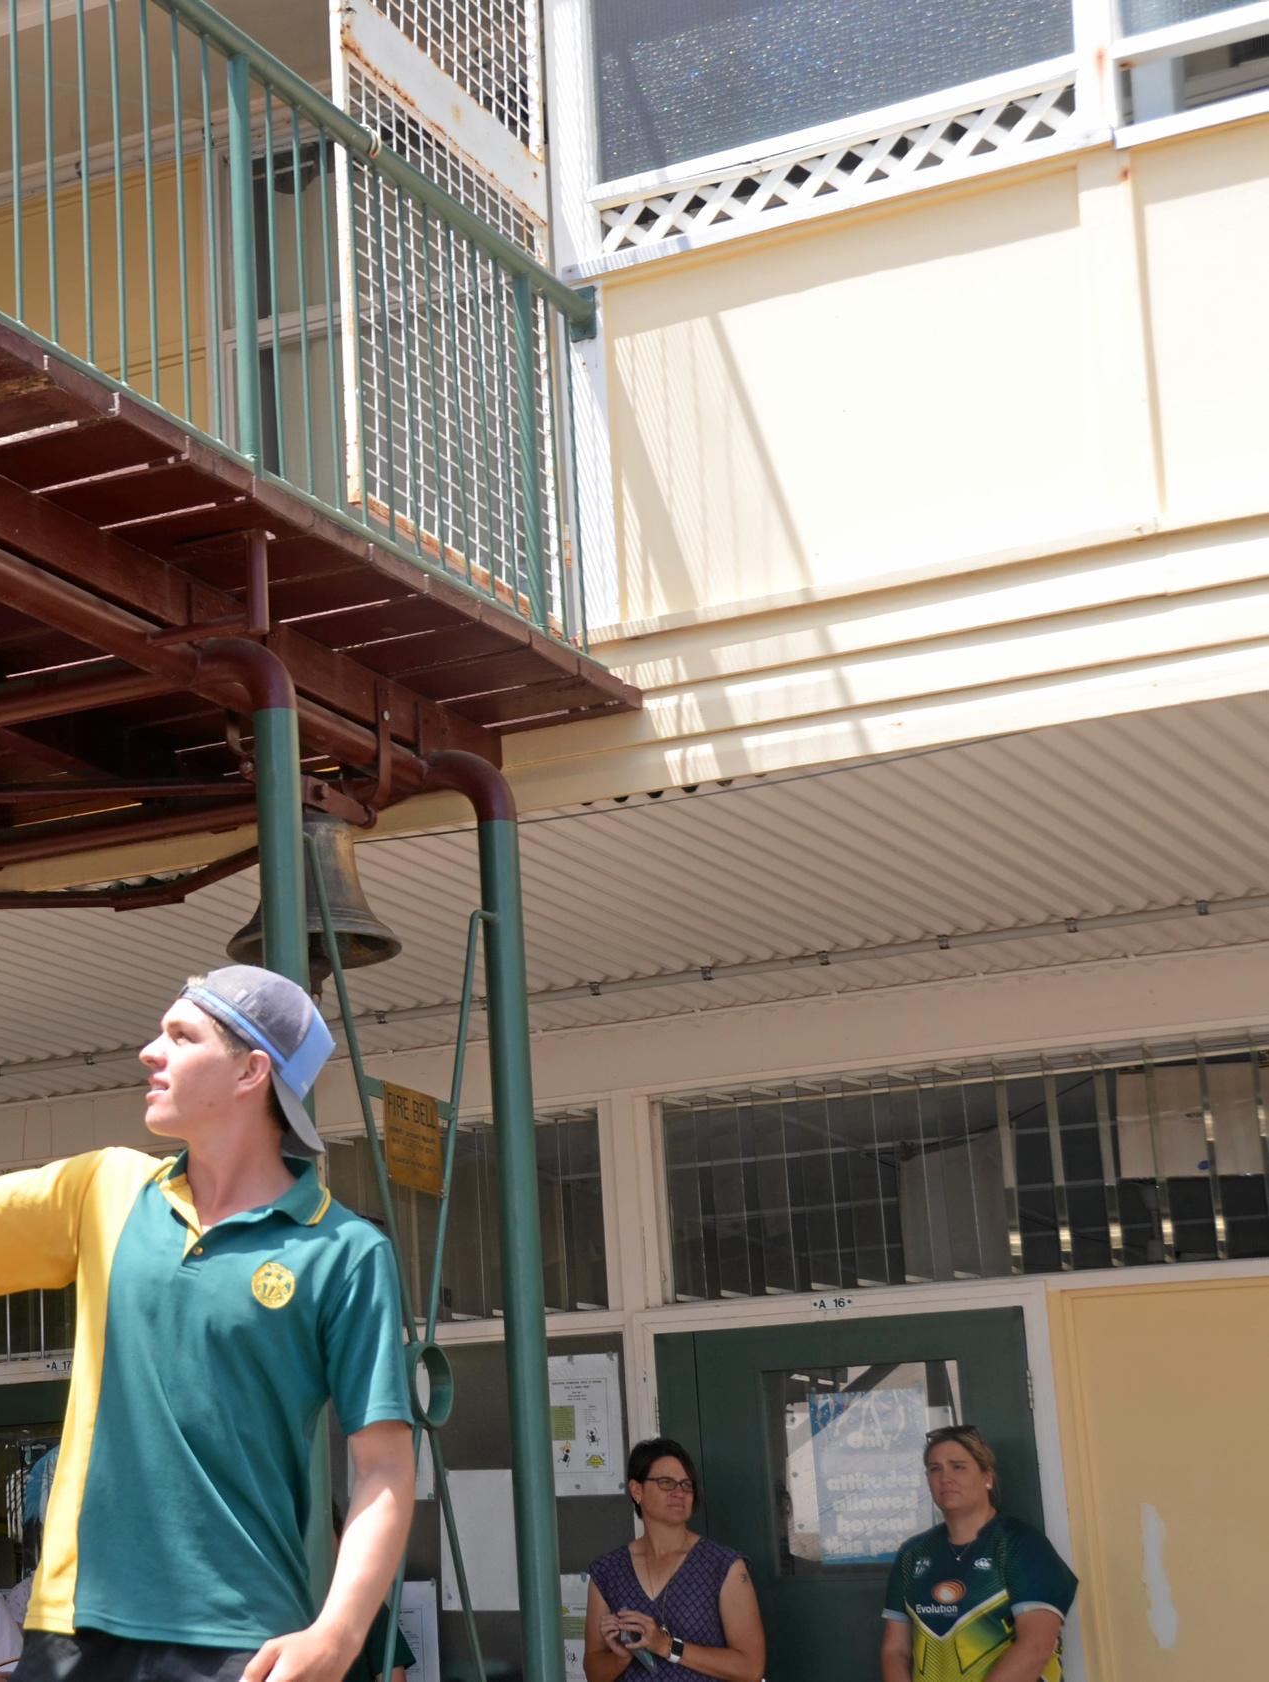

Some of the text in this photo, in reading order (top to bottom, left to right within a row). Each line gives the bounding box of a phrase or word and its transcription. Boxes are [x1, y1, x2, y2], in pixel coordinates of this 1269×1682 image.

[387, 1091, 437, 1129] FIRE BELL
[818, 1297, 846, 1309] A 16
[50, 1361, 57, 1370] A
[847, 1429, 892, 1450] Only
[826, 1471, 921, 1490] attitudes
[832, 1490, 918, 1512] allowed
[836, 1511, 918, 1536] beyond
[824, 1534, 904, 1556] this poi
[915, 1604, 958, 1614] Evolution
